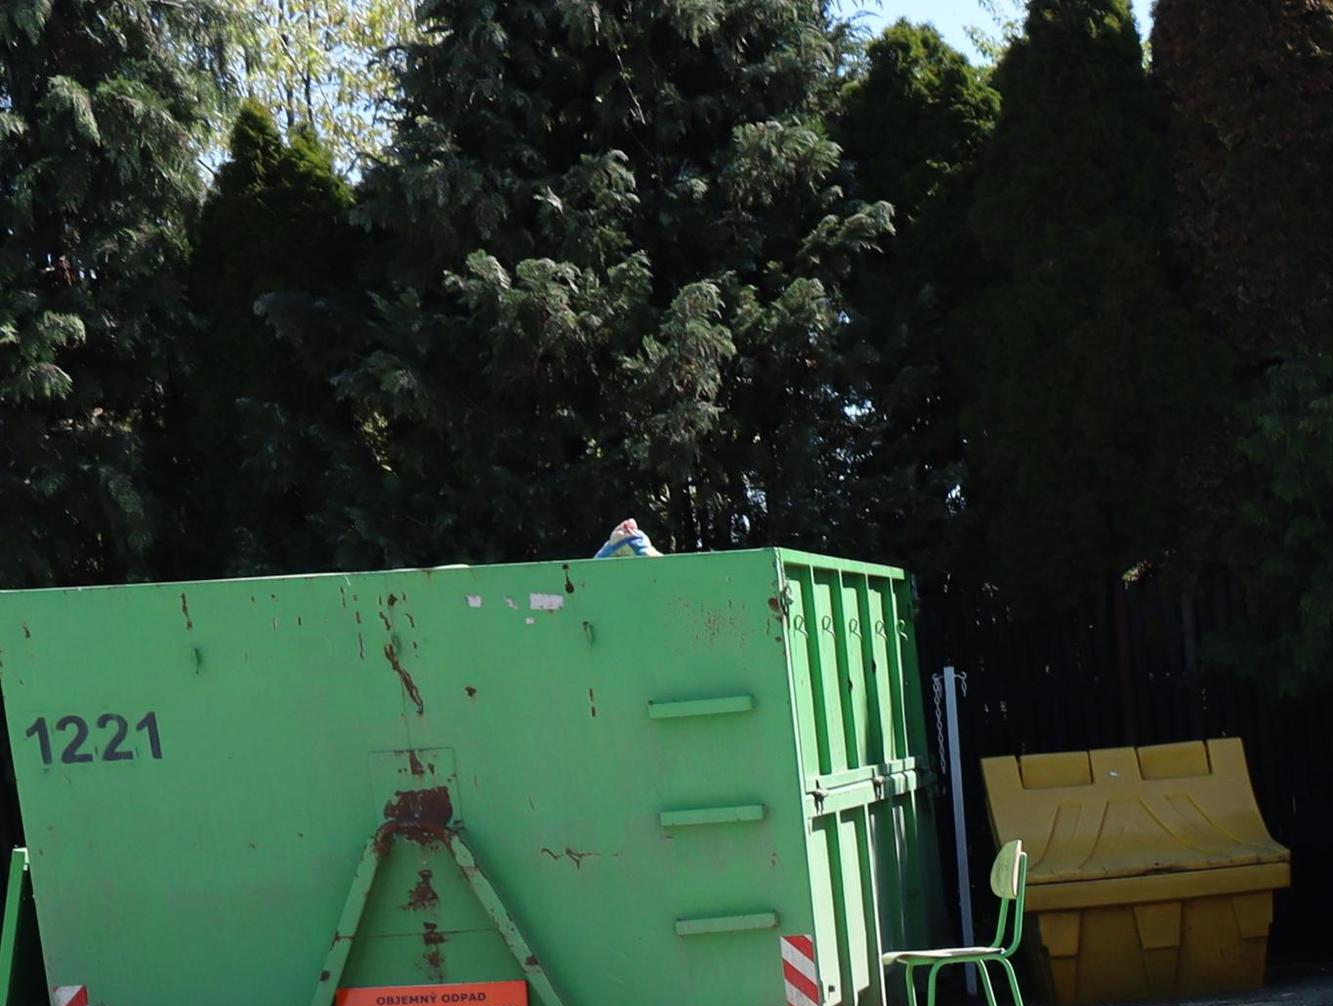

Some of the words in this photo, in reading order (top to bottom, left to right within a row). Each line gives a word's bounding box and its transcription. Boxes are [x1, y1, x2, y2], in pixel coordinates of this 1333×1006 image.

[25, 711, 162, 765] 1221
[376, 993, 437, 1006] OBJEMNÝ
[441, 992, 486, 1002] ODPAD
